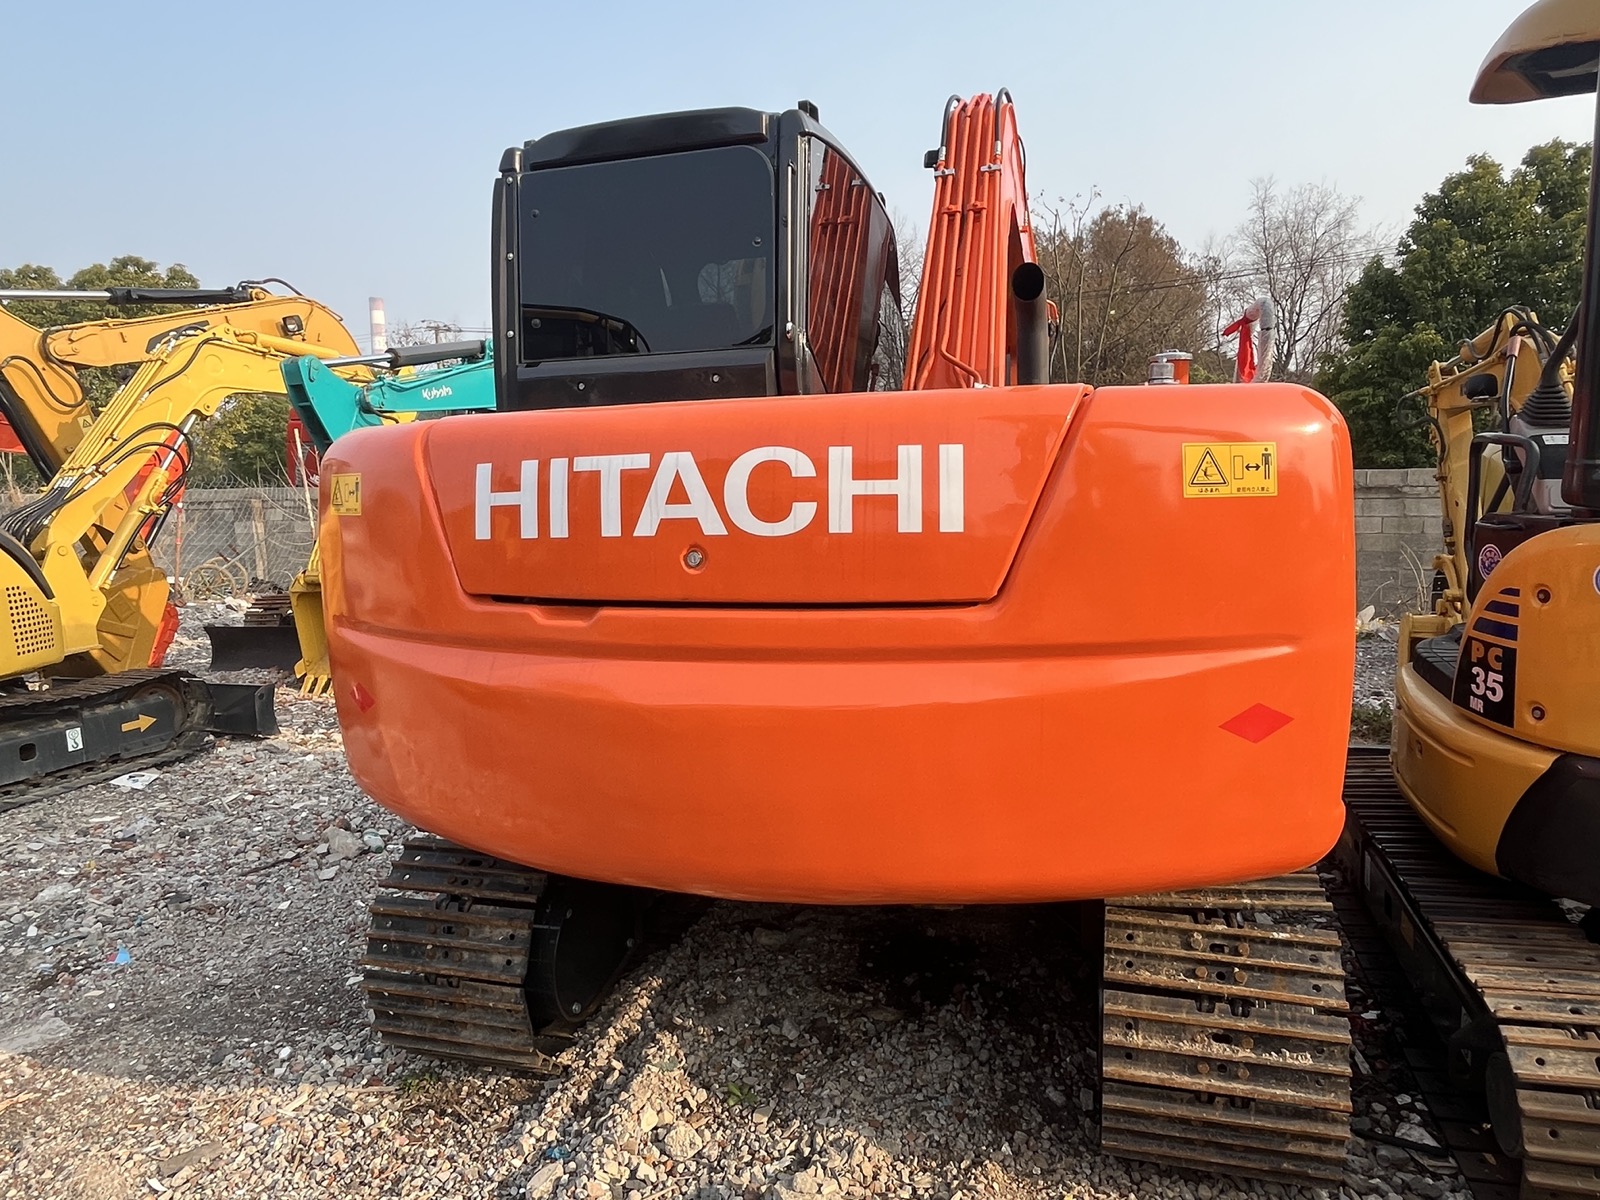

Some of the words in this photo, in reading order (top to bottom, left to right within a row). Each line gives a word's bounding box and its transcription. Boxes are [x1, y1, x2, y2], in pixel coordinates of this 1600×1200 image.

[474, 443, 965, 540] HITACHI
[1471, 640, 1503, 671] PC
[1470, 666, 1504, 703] 35
[1469, 695, 1484, 713] MR
